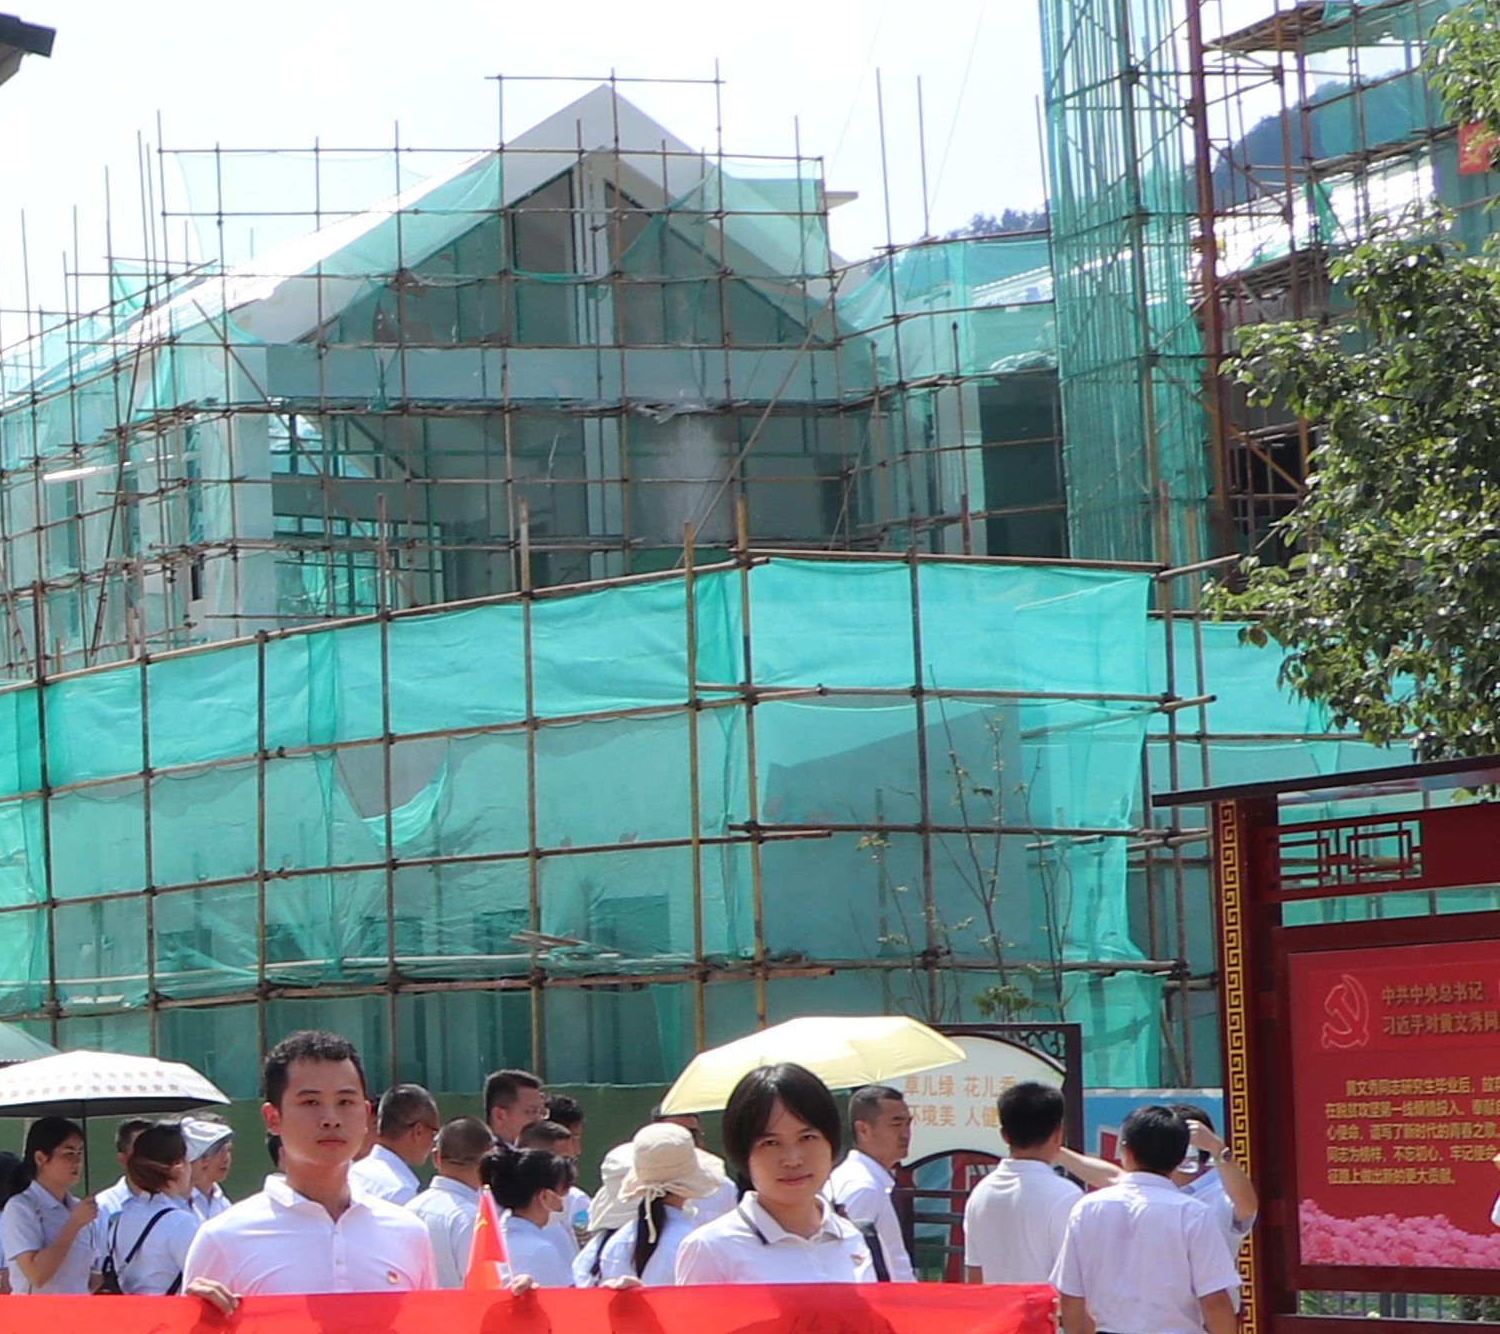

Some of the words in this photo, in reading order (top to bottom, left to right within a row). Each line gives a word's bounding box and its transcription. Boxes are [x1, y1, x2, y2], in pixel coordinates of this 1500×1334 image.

[1382, 980, 1500, 1006] 中共中央总书记、
[1382, 1011, 1500, 1036] 习近平对黄文秀同
[904, 1075, 955, 1097] 草儿绿
